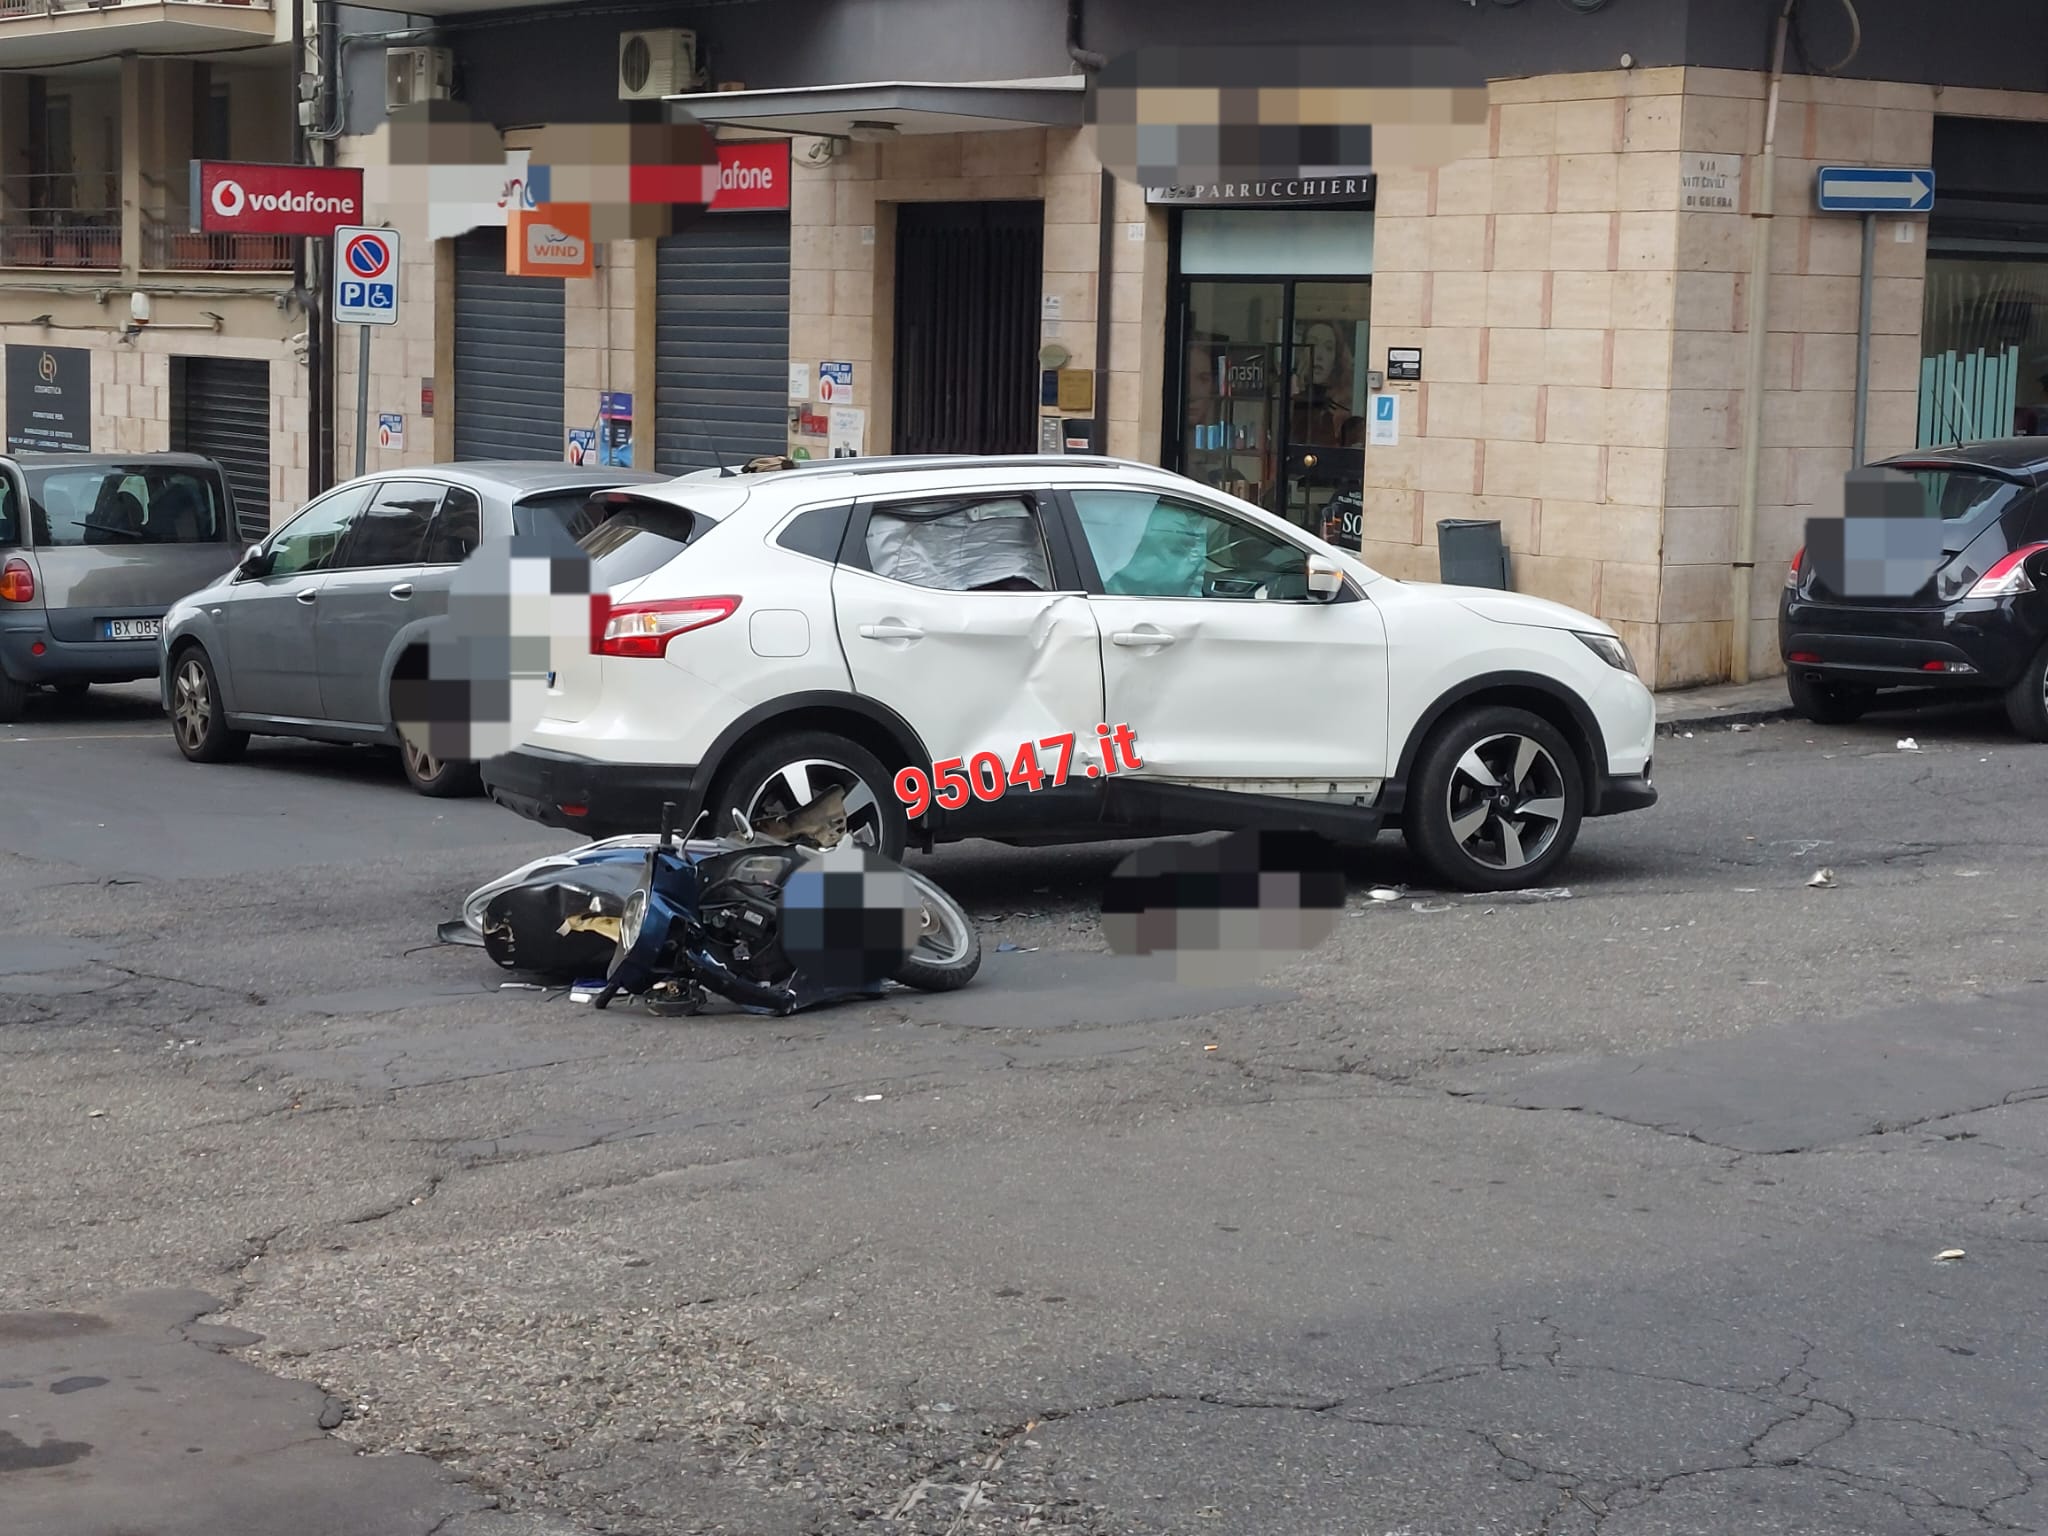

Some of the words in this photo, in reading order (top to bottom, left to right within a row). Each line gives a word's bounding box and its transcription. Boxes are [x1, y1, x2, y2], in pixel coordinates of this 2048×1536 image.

[1195, 178, 1367, 199] PARRUCCHIERI
[248, 190, 354, 214] vodafone
[534, 244, 578, 258] WIND
[344, 283, 361, 305] P
[113, 621, 130, 635] BX
[135, 620, 160, 635] 083
